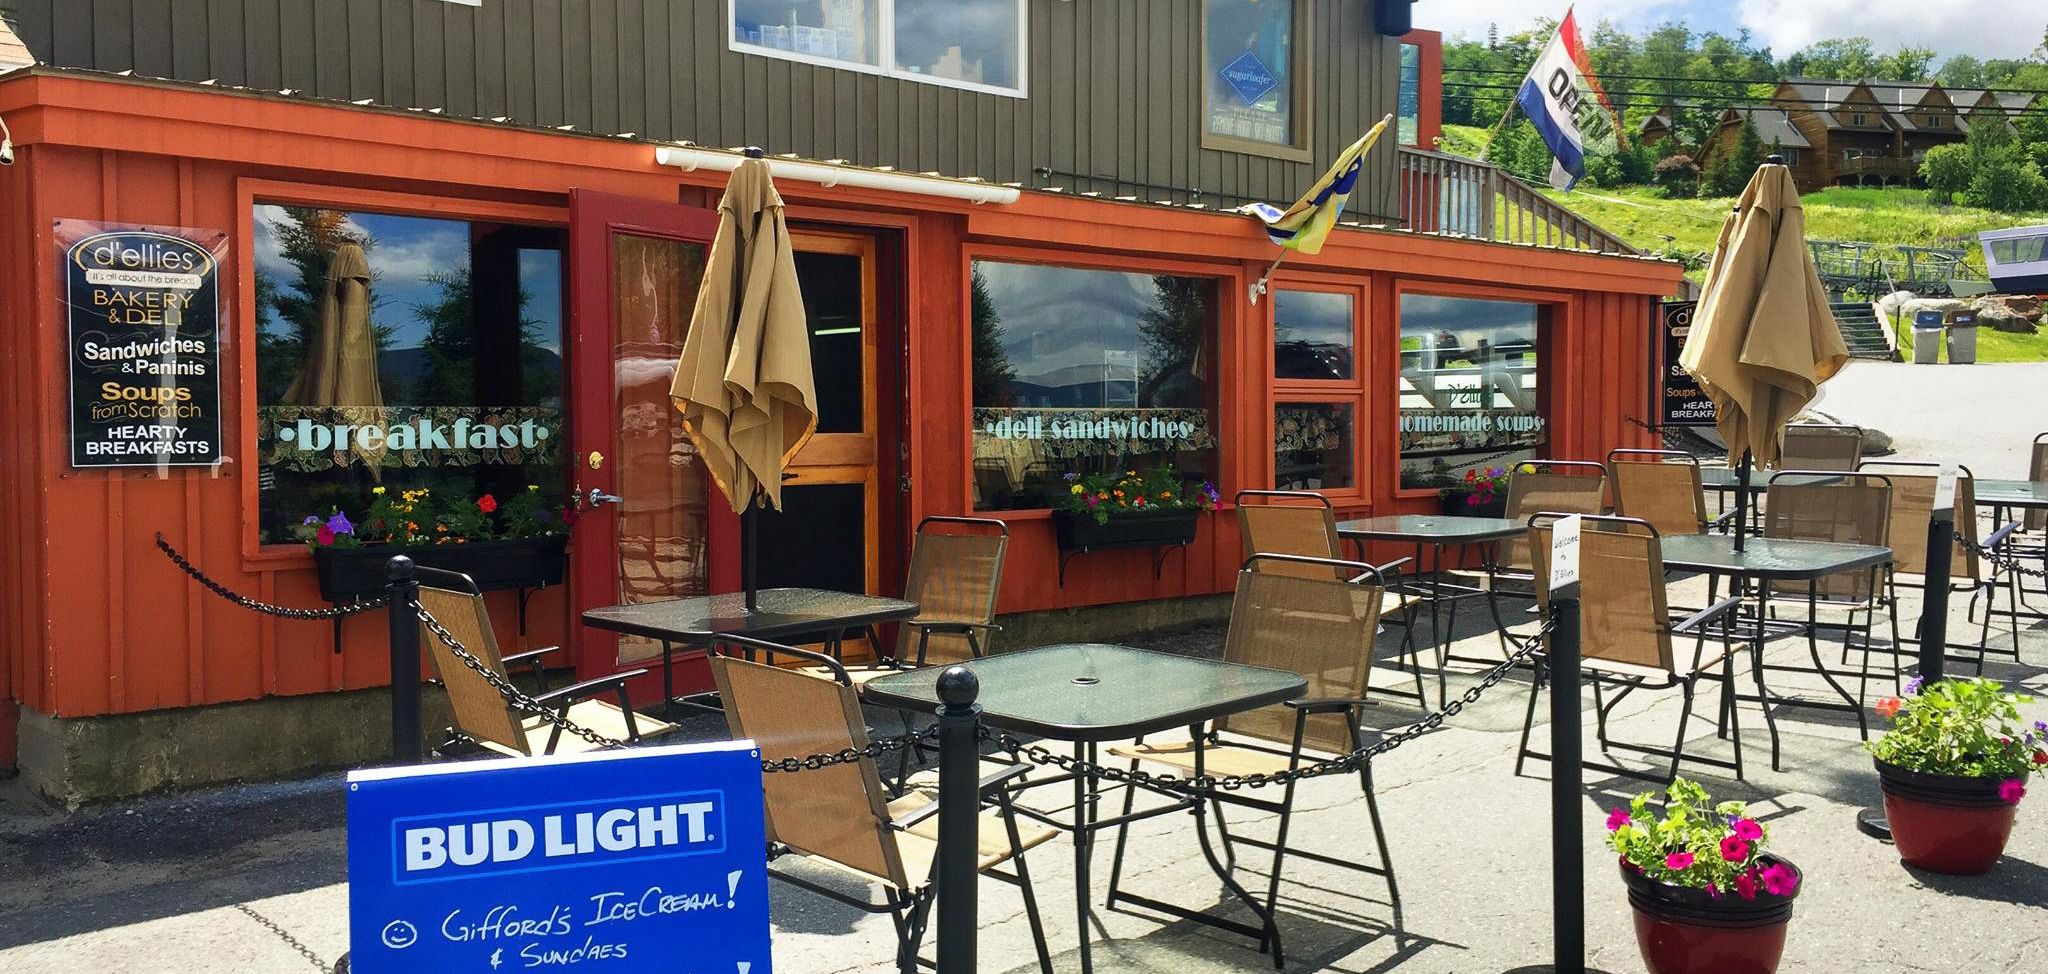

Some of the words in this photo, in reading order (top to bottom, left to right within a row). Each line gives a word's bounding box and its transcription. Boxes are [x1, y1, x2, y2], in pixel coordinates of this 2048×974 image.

[1549, 67, 1613, 140] OPEN
[94, 241, 193, 270] d'ellies
[107, 272, 117, 280] all
[118, 273, 147, 282] about
[148, 274, 161, 283] the
[94, 289, 194, 309] BAKERY
[108, 308, 121, 324] &
[126, 308, 182, 326] DELI
[83, 337, 206, 361] Sandwiches
[121, 362, 134, 374] &
[136, 359, 206, 375] Paninis
[101, 382, 192, 405] Soups
[1666, 387, 1696, 398] Soups
[91, 403, 127, 420] from
[128, 402, 201, 418] Scratch
[1671, 410, 1716, 418] BREAKF
[1683, 401, 1713, 410] HEAR
[108, 425, 188, 439] HEARTY
[995, 416, 1042, 440] deli
[1051, 416, 1190, 440] sandwiches
[1496, 415, 1540, 432] soups
[297, 418, 539, 451] breakfast
[86, 441, 210, 455] BREAKFASTS
[405, 819, 535, 872] BUD
[544, 801, 714, 857] LIGHT
